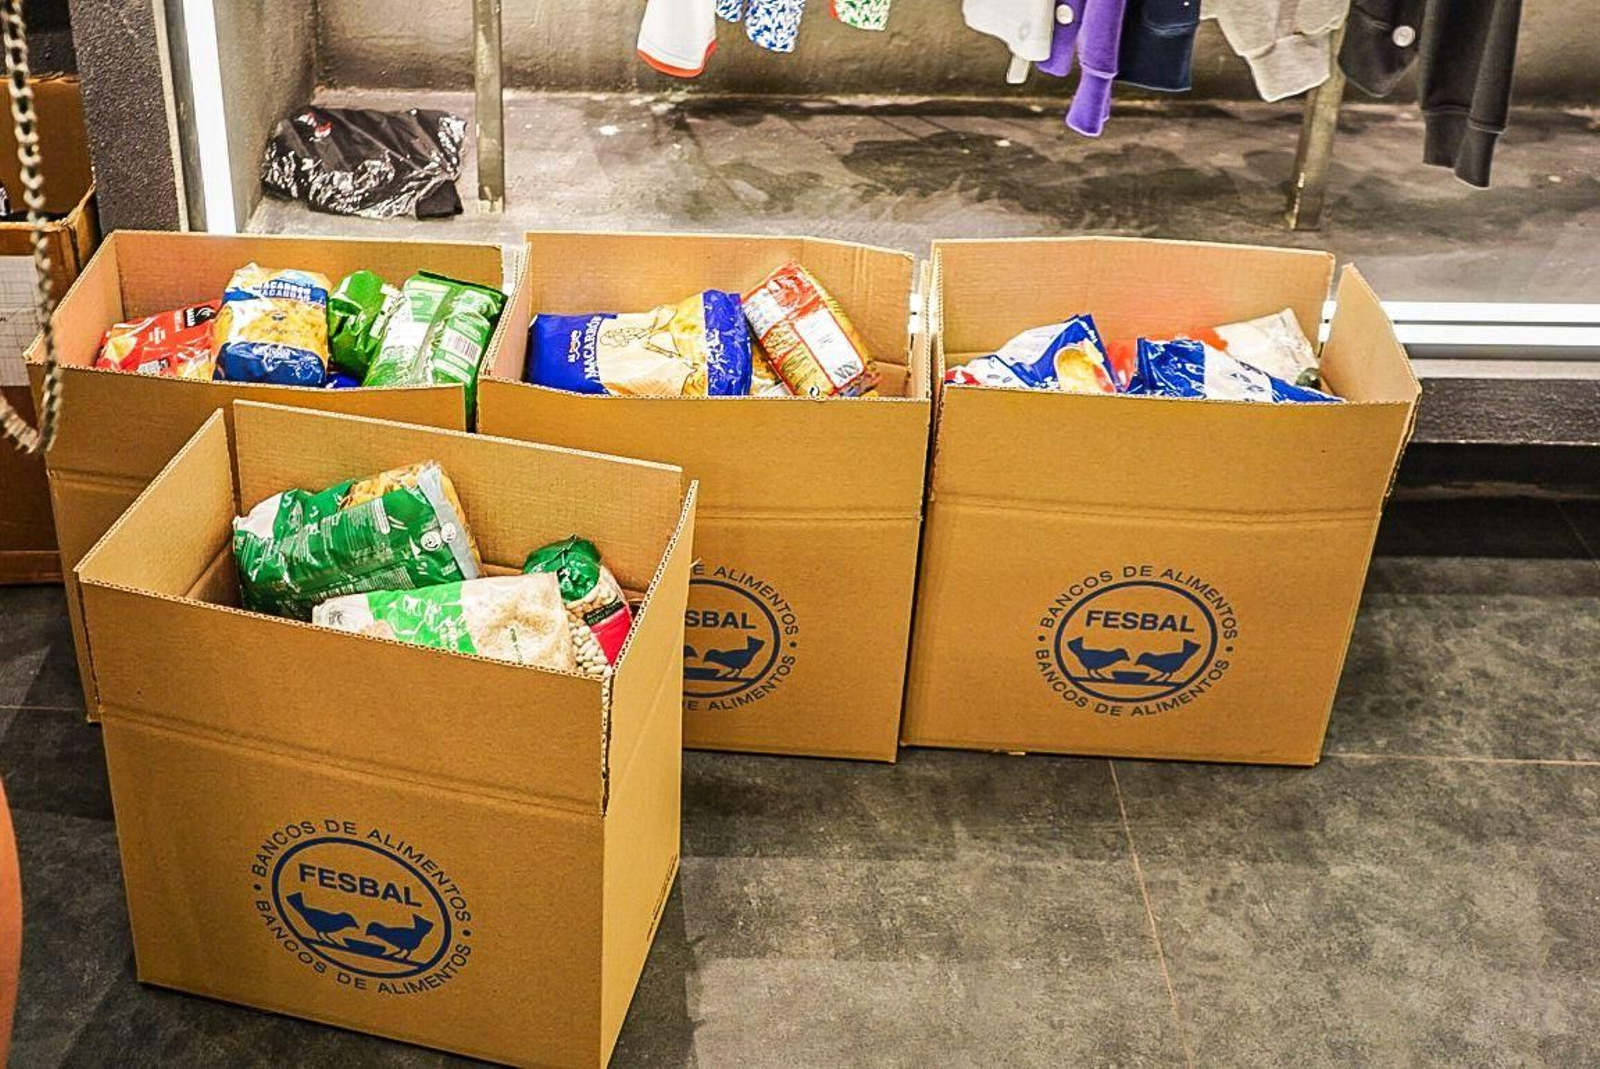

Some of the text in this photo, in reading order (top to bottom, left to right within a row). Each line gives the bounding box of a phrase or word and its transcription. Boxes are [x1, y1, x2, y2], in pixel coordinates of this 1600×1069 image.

[685, 610, 757, 629] SBAL
[713, 565, 799, 635] ALIMENTOS
[1040, 565, 1238, 640] BANCOS DE ALIMENTOS
[1085, 610, 1195, 632] FESBAL
[708, 655, 796, 711] ALIMENTOS
[1036, 649, 1230, 717] BANCOS DE ALIMENTOS
[252, 819, 472, 924] BANCOS DE ALIMENTOS
[299, 863, 422, 908] FESBAL
[256, 900, 472, 995] BANCOS DE ALIMENTOS
